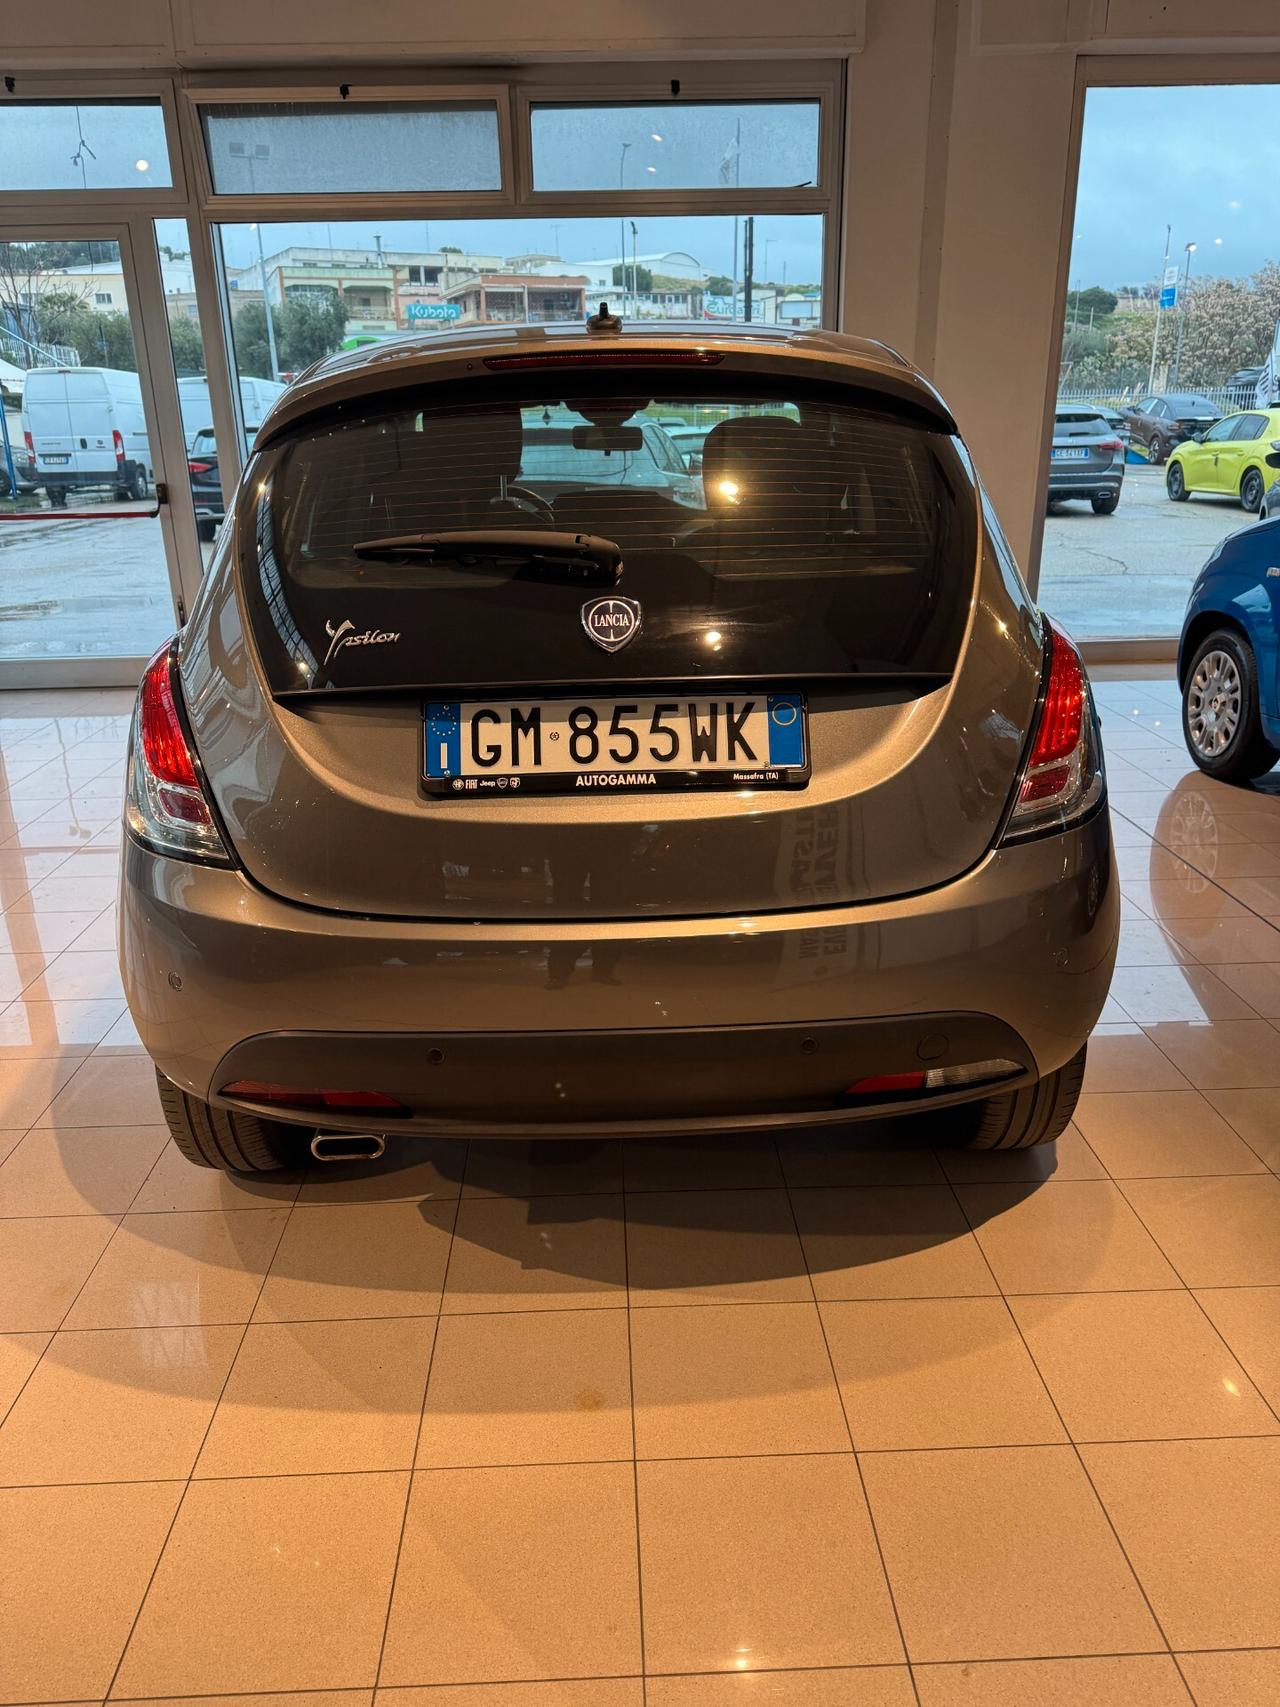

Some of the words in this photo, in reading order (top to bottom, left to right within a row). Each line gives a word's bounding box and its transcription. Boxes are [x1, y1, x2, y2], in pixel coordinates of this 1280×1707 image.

[411, 306, 456, 318] Kubota
[594, 613, 630, 627] LANCIA
[324, 619, 401, 666] Ypsilon
[471, 707, 542, 767] GM
[568, 702, 758, 765] 855WK
[575, 773, 657, 787] AUTOGAMMA
[733, 772, 764, 781] Massafra
[765, 771, 779, 781] (TA)
[465, 778, 478, 790] FIAT
[480, 779, 496, 788] Jeep
